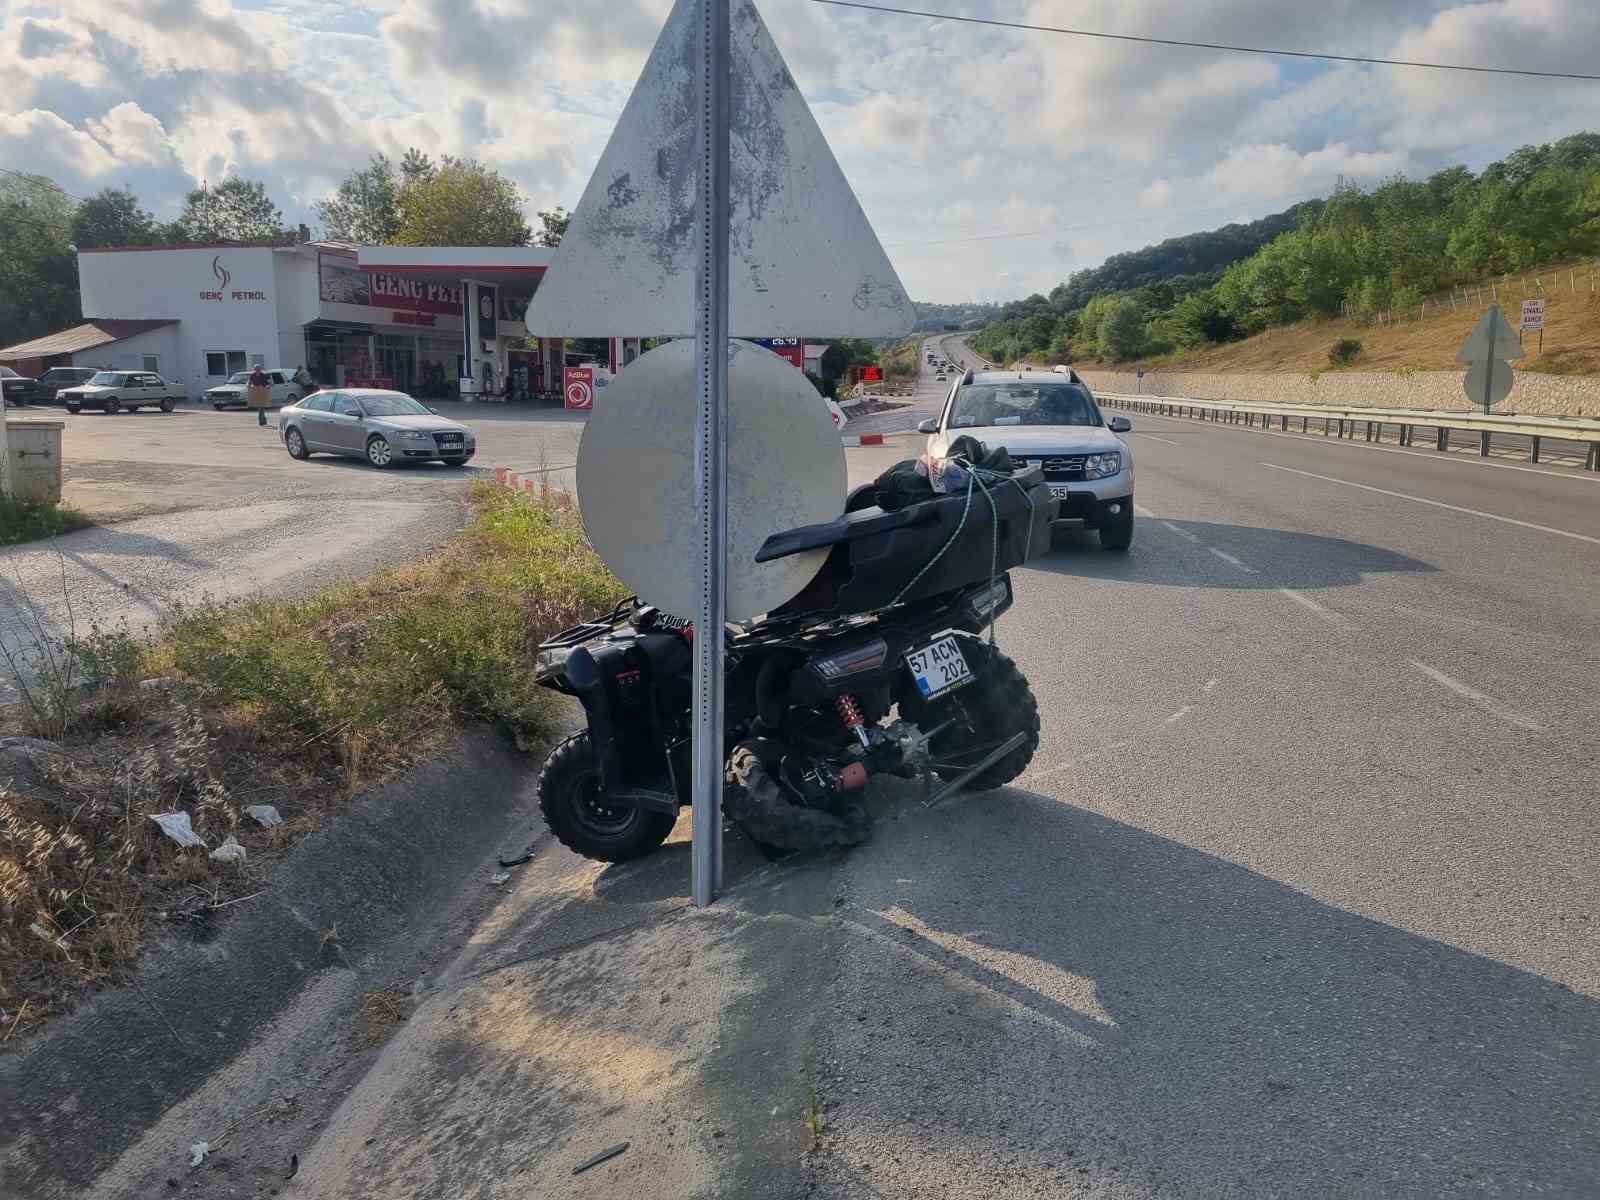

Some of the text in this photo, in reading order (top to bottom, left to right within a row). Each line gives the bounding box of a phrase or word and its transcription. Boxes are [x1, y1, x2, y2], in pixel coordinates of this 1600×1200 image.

[199, 291, 266, 302] GENÇ PETROL
[909, 639, 959, 673] 57 ACN
[940, 658, 968, 682] 202
